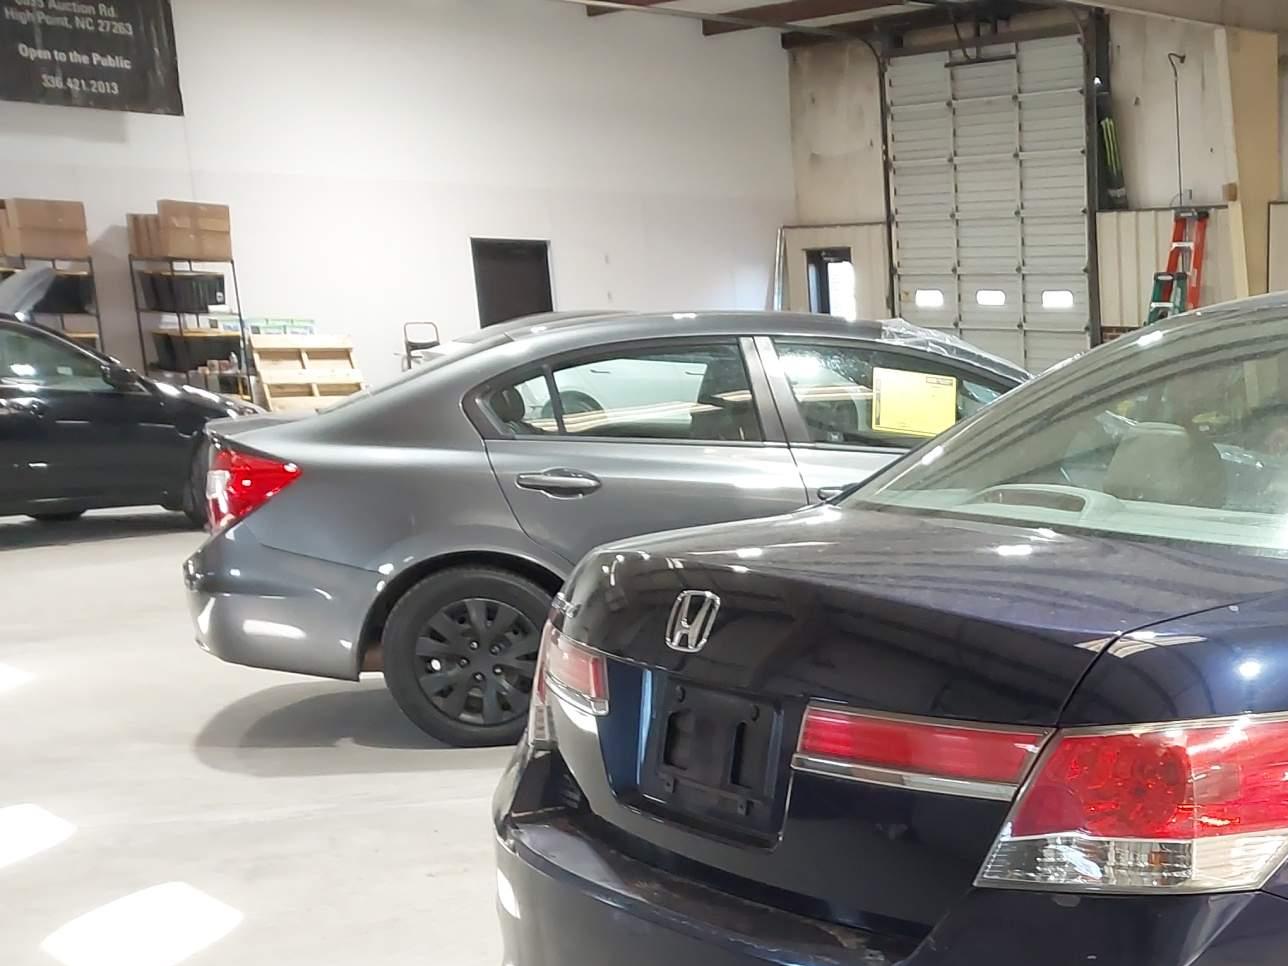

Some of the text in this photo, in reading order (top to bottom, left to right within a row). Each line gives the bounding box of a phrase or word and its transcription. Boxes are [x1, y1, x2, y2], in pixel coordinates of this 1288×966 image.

[48, 0, 96, 15] Auction
[4, 7, 33, 25] High
[75, 16, 95, 31] NC
[98, 19, 134, 36] 27263
[18, 43, 132, 69] Open to the Public
